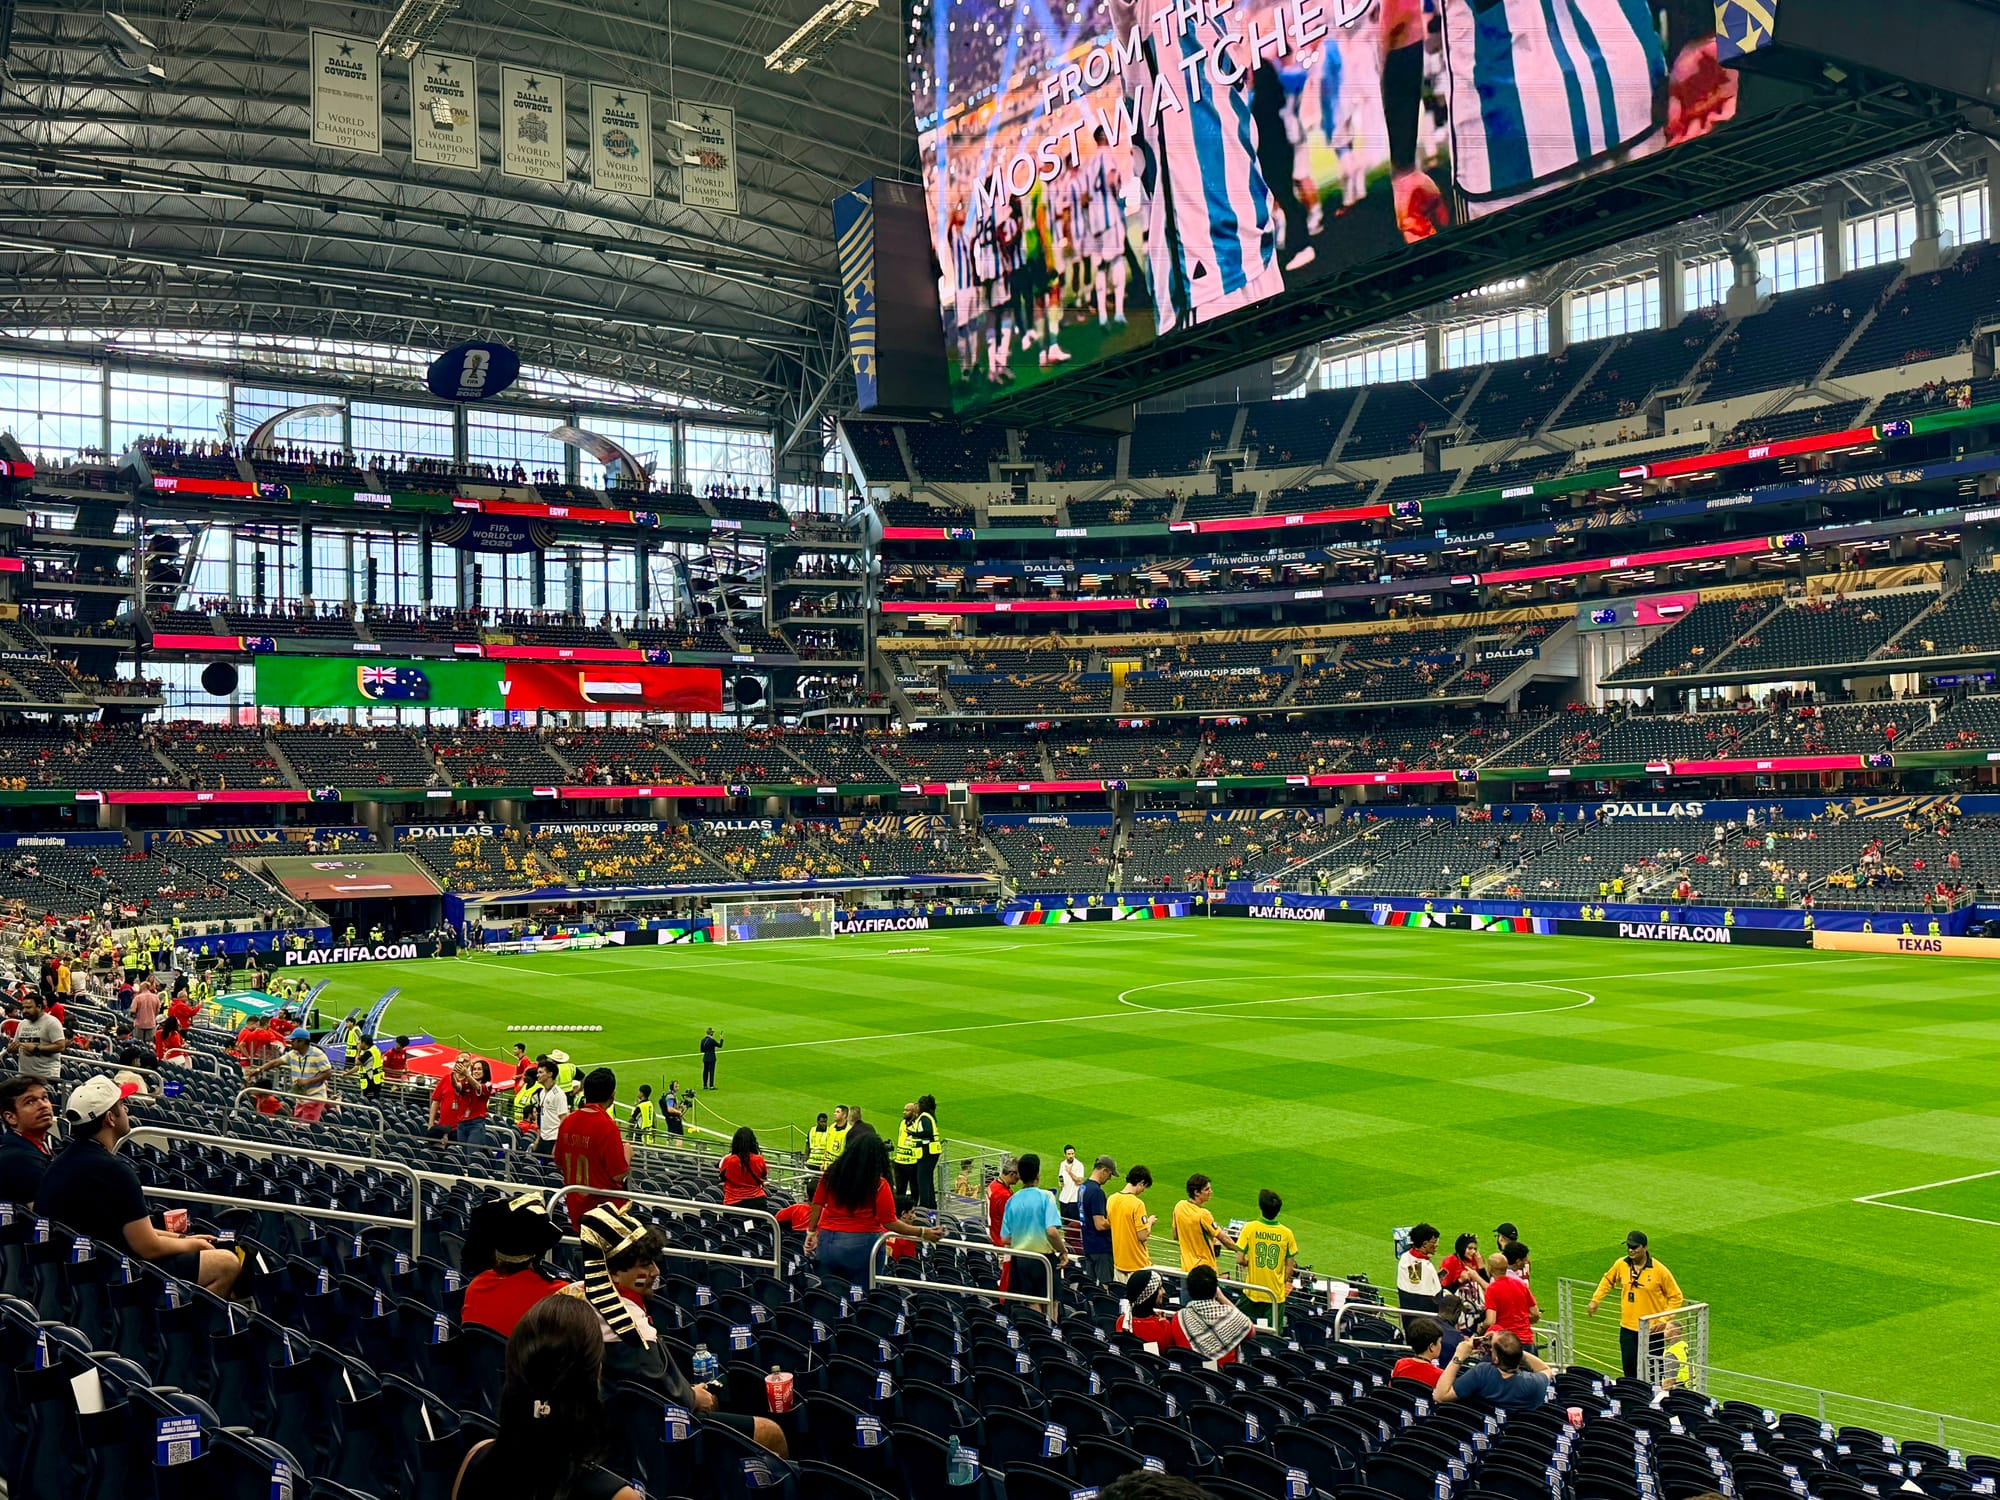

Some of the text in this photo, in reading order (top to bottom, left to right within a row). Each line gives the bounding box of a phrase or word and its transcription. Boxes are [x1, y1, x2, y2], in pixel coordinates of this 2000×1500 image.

[1041, 0, 1235, 114] FROM THE
[329, 57, 363, 71] DALLAS
[324, 66, 367, 81] COWBOYS
[427, 76, 460, 89] DALLAS
[423, 84, 464, 98] COWBOYS
[517, 91, 548, 104] DALLAS
[513, 99, 552, 113] COWBOYS
[973, 0, 1373, 218] MOST WATCHED
[328, 112, 365, 127] WORLD
[449, 107, 469, 119] OWL
[605, 108, 636, 120] DALLAS
[602, 116, 640, 130] COWBOYS
[317, 122, 376, 140] CHAMPIONS
[428, 130, 463, 144] WORLD
[336, 136, 356, 147] 1971
[417, 139, 474, 156] CHAMPIONS
[517, 143, 551, 158] WORLD
[436, 152, 456, 163] 1977
[507, 152, 561, 169] CHAMPIONS
[524, 166, 544, 177] 1992
[606, 159, 639, 173] WORLD
[596, 168, 648, 185] CHAMPIONS
[694, 175, 725, 188] WORLD
[614, 182, 633, 192] 1993
[685, 184, 734, 198] CHAMPIONS
[701, 197, 720, 206] 1995
[456, 390, 482, 398] 2026
[1748, 447, 1769, 459] EGYPT
[154, 478, 178, 489] EGYPT
[353, 493, 392, 504] AUSTRALIA
[1502, 486, 1534, 499] AUSTRALIA
[549, 507, 569, 517] EGYPT
[489, 524, 510, 533] FIFA
[1056, 528, 1087, 537] AUSTRALIA
[472, 530, 525, 541] WORLD CUP
[1444, 532, 1495, 546] DALLAS
[480, 539, 513, 548] 2026
[1212, 552, 1305, 566] FIFA WORLD CUP 2026
[1024, 563, 1075, 573] DALLAS
[2, 652, 48, 662] DALLAS
[1485, 648, 1533, 659] DALLAS
[1179, 668, 1210, 678] WORLD
[1212, 668, 1229, 677] CUP
[1230, 666, 1261, 676] 2026
[1603, 802, 1704, 818] DALLAS
[409, 826, 493, 838] DALLAS
[540, 822, 658, 834] FIFA WORLD CUP 2026
[704, 820, 772, 832] DALLAS
[16, 836, 65, 846] #FIFAWorldCup
[955, 907, 974, 915] FIFA
[1249, 905, 1325, 921] PLAY.FIFA.COM
[1373, 903, 1393, 911] FIFA
[832, 917, 929, 934] PLAY.FIFA.COM
[1619, 923, 1731, 945] PLAY.FIFA.COM
[1897, 938, 1942, 953] TEXAS
[285, 943, 417, 966] PLAY.FIFA.COM
[1255, 1231, 1282, 1243] MONDO
[1255, 1242, 1281, 1271] 99
